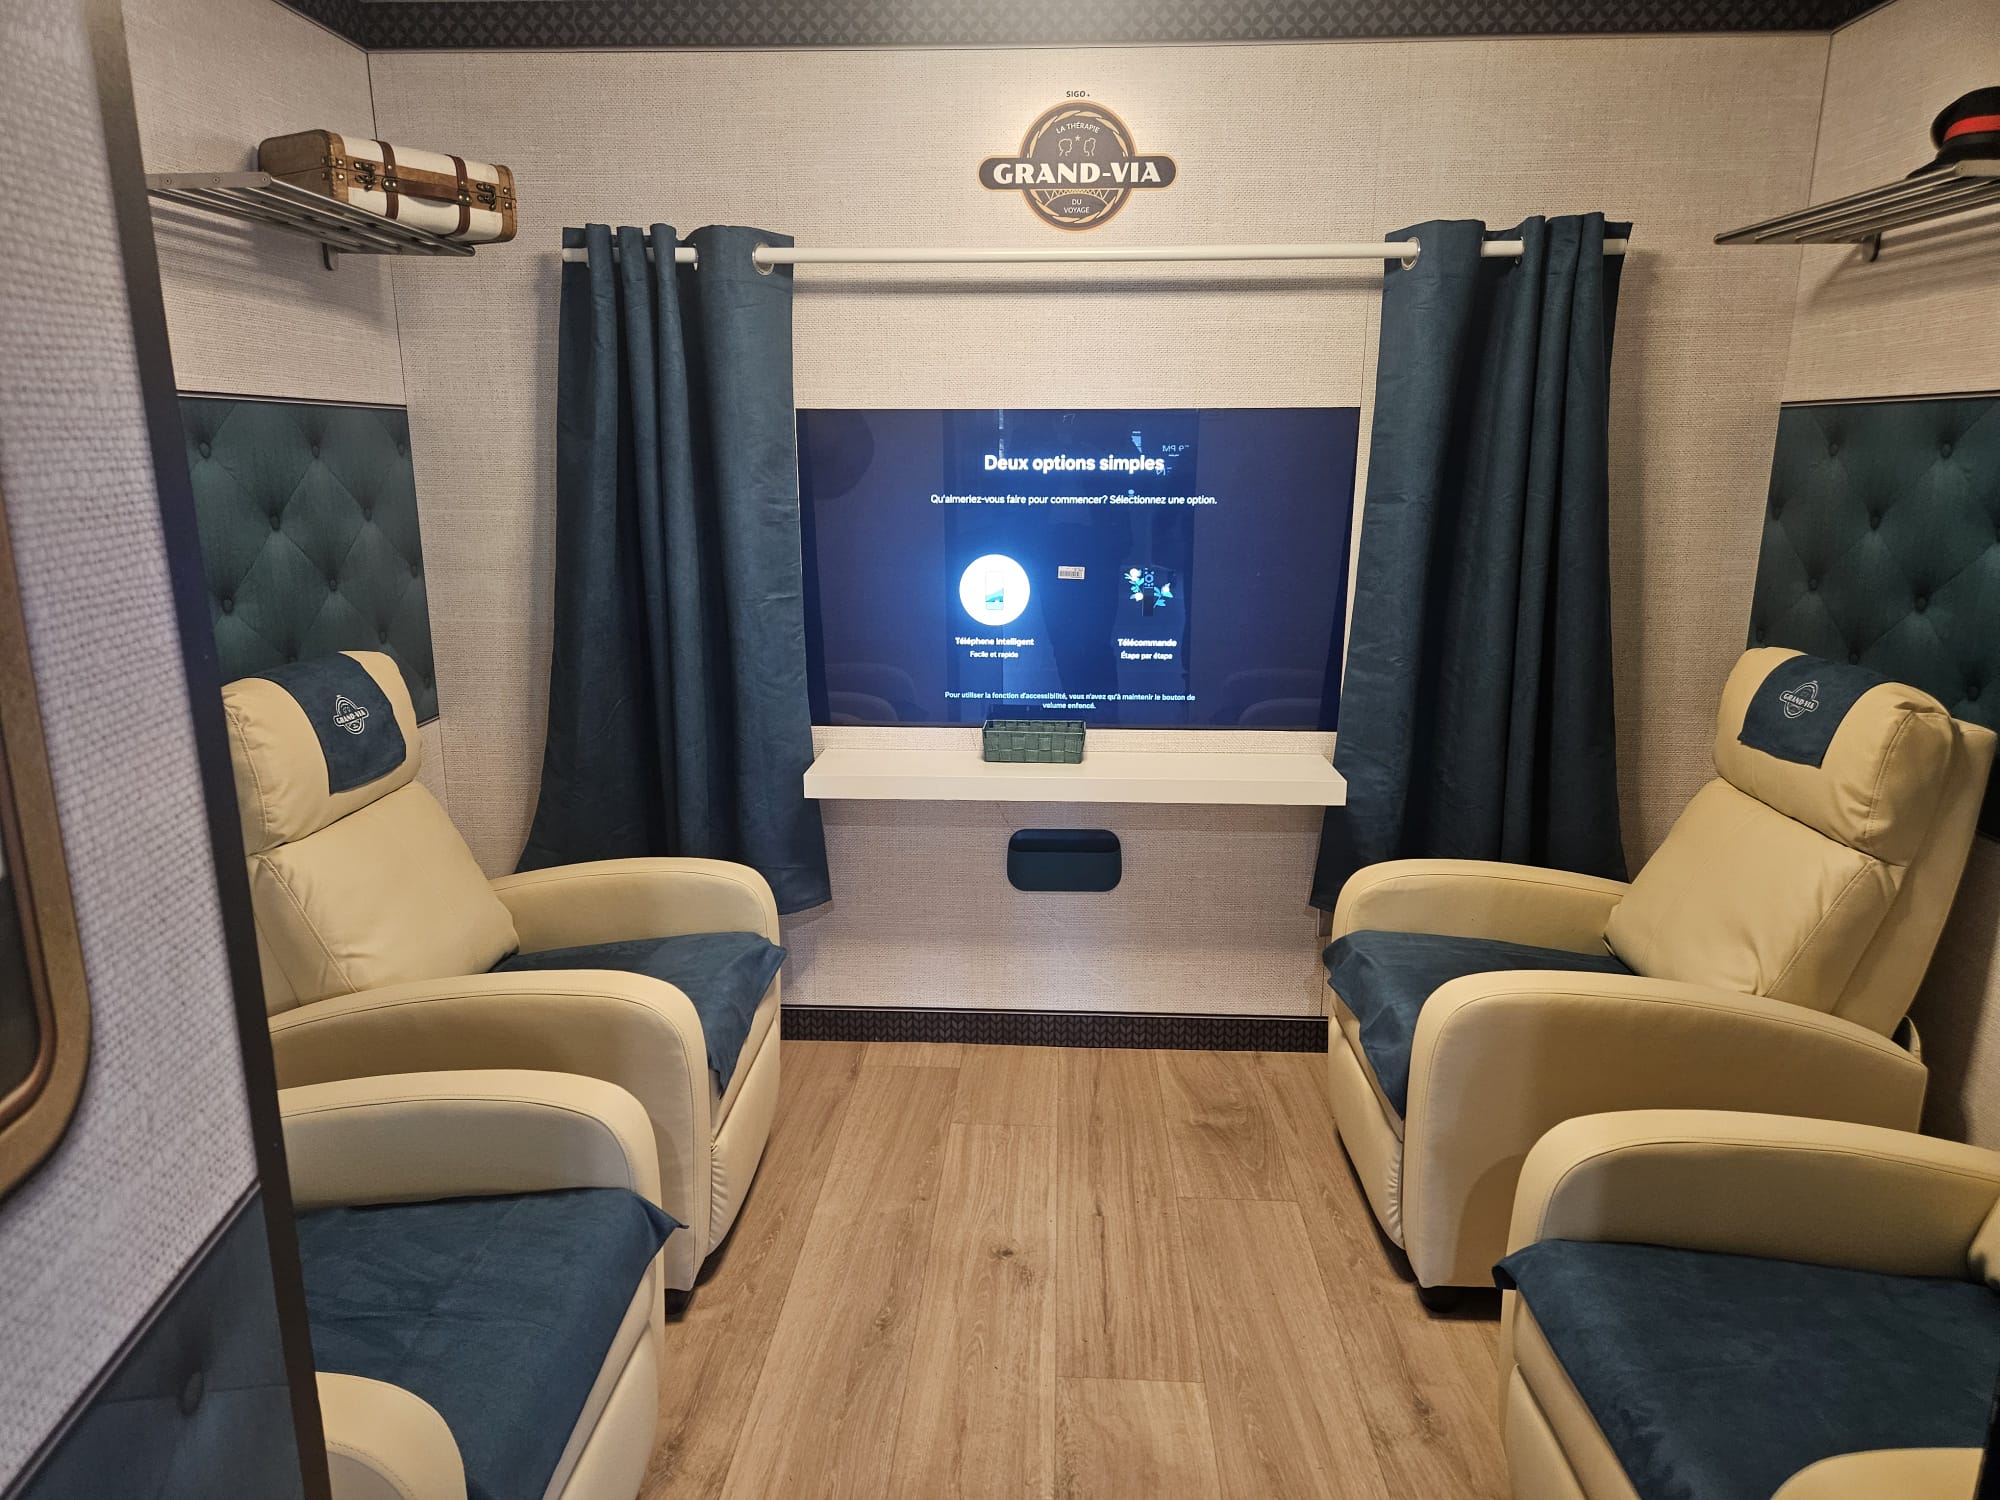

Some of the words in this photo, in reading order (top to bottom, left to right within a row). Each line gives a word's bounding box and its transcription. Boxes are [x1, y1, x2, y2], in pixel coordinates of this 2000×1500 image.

[1056, 126, 1066, 134] LA
[1066, 121, 1101, 134] THÉRAPIE
[993, 160, 1162, 185] GRAND-VIA
[1071, 198, 1082, 206] DU
[1063, 206, 1090, 214] VOYAGE
[984, 454, 1029, 471] Deux
[1032, 454, 1096, 474] options
[1099, 454, 1165, 474] simples
[930, 494, 1005, 504] Qu'aimeriez-vous
[1006, 494, 1027, 504] faire
[1028, 496, 1048, 506] pour
[1050, 495, 1108, 504] commencer?
[1109, 494, 1167, 505] Sélectionnez
[1168, 496, 1185, 505] une
[1186, 495, 1217, 506] option.
[954, 636, 995, 647] Téléphone
[1117, 638, 1178, 647] Télécommande
[969, 650, 989, 658] Facile
[998, 651, 1019, 659] rapide
[1120, 650, 1140, 660] Étape
[1141, 653, 1152, 661] par
[1153, 651, 1173, 661] étape
[961, 691, 984, 699] utiliser
[1122, 693, 1154, 701] maintenir
[1154, 693, 1161, 701] le
[1162, 693, 1186, 701] bouton
[1042, 701, 1066, 709] volume
